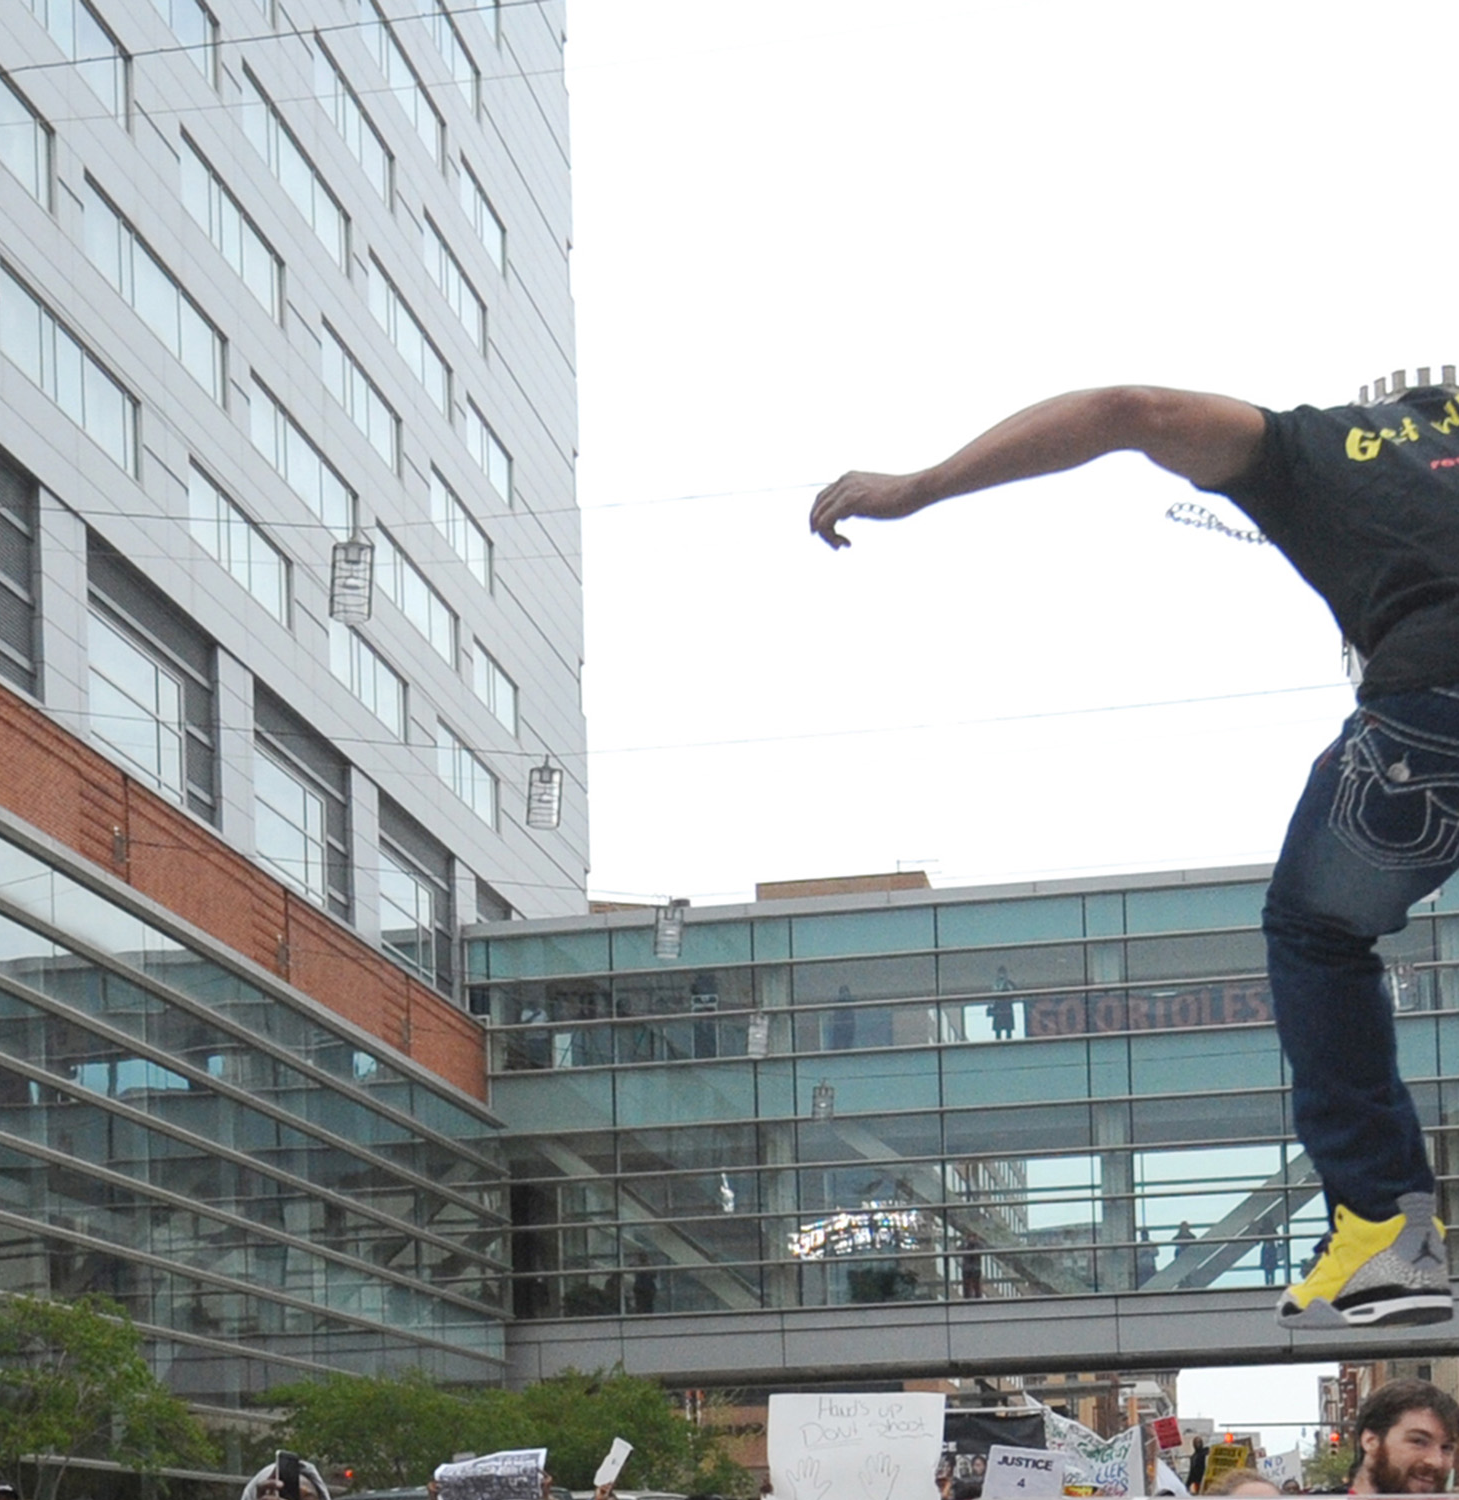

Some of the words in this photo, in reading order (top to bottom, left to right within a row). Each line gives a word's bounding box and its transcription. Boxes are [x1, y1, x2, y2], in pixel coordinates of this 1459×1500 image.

[1030, 993, 1087, 1036] GO
[1095, 987, 1270, 1033] ORIOLES
[997, 1454, 1054, 1473] JUSTICE
[1016, 1478, 1026, 1489] 4
